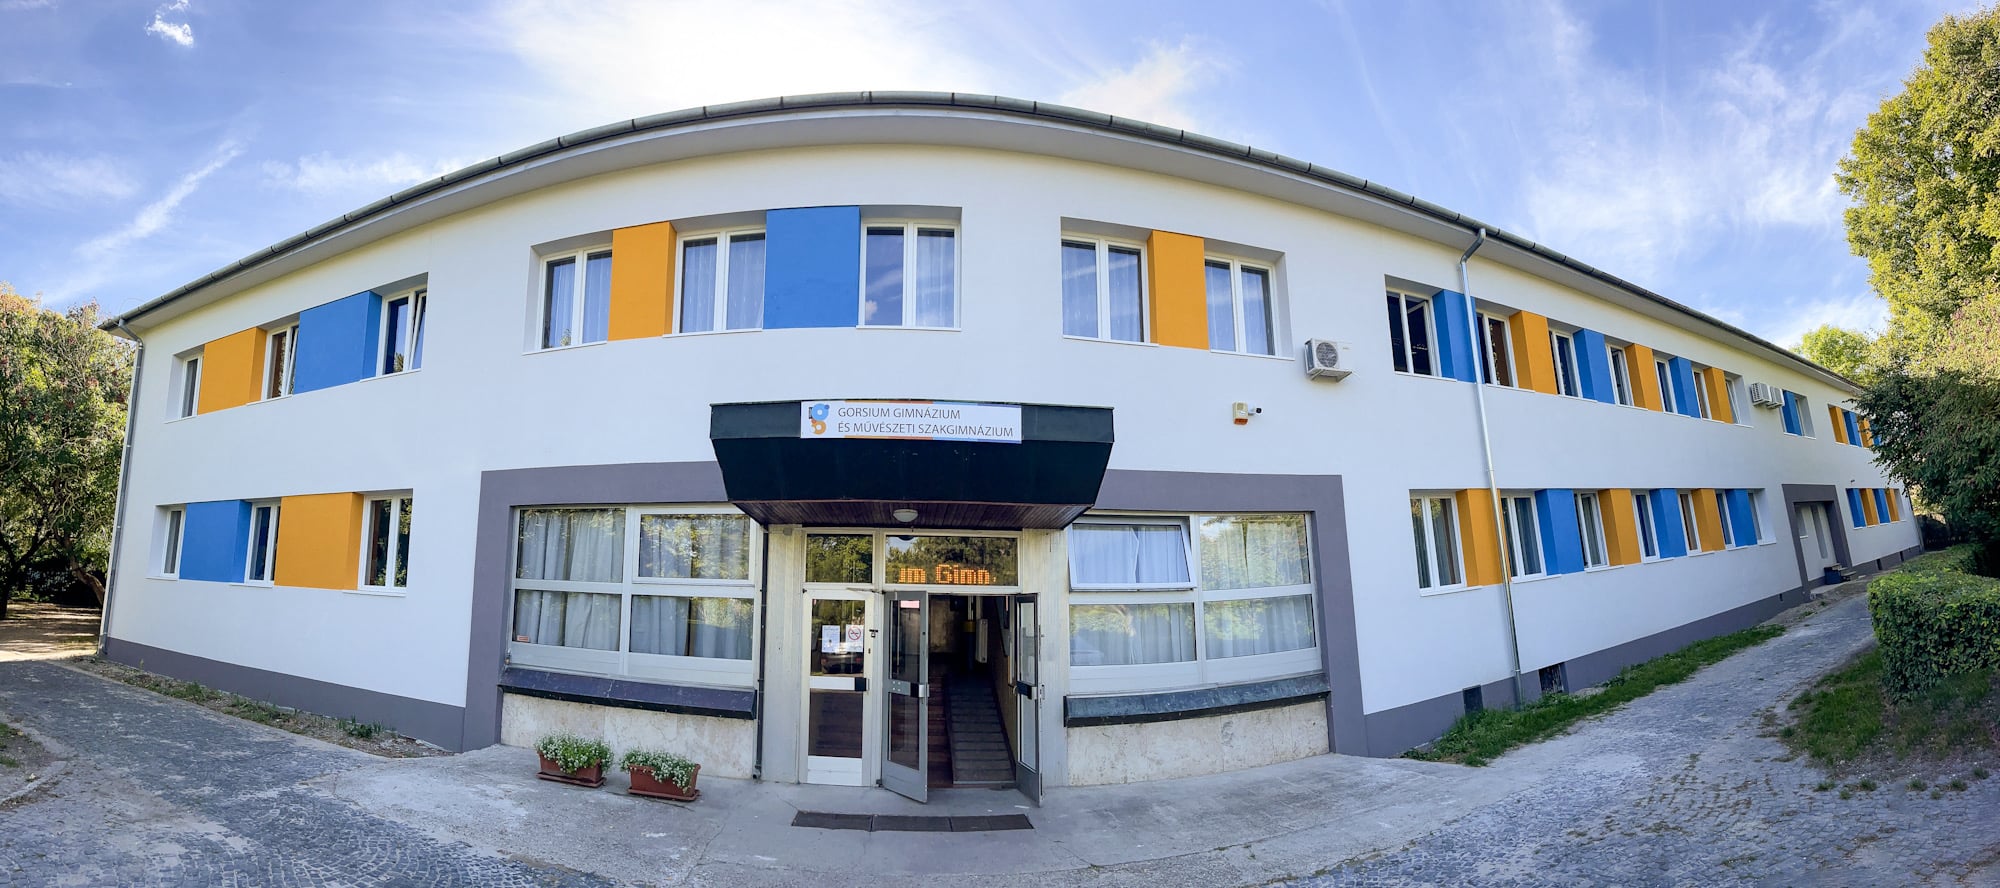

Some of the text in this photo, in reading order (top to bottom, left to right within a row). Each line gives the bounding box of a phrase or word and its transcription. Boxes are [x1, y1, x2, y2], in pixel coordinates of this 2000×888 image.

[838, 406, 961, 420] GORSIUM GIMNÁZIUM
[838, 421, 1013, 437] ÉS MŰVÉSZETI SZAKGIMNÁZIUM
[936, 563, 996, 585] Gimn
